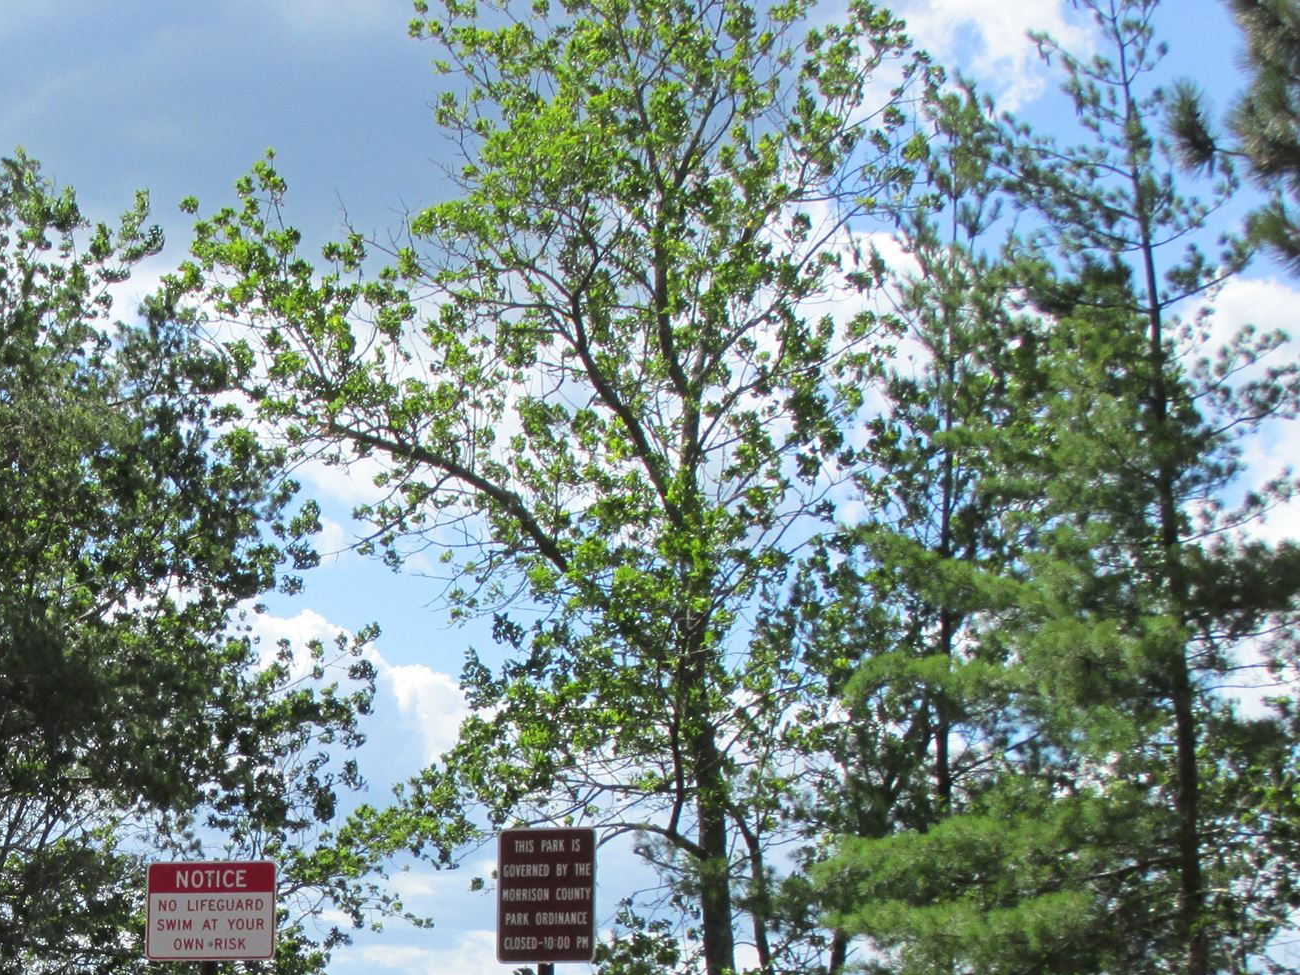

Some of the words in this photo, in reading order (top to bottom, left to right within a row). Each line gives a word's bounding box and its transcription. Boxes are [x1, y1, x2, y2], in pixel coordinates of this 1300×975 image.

[514, 840, 534, 853] THIS
[541, 839, 565, 853] PARK
[571, 839, 581, 852] IS
[503, 864, 550, 877] GOVERNED
[556, 864, 568, 876] BY
[575, 863, 591, 876] THE
[175, 870, 247, 888] NOTICE
[502, 888, 550, 901] MORRISON
[556, 887, 592, 900] COUNTY
[158, 899, 177, 912] NO
[187, 899, 264, 912] LIFEGUARD
[157, 919, 192, 931] SWIM
[202, 919, 218, 931] AT
[227, 918, 265, 931] YOUR
[505, 913, 529, 925] PARK
[535, 912, 588, 925] ORDINANCE
[173, 938, 204, 951] OWN
[214, 938, 246, 950] RISK
[576, 936, 589, 949] PM
